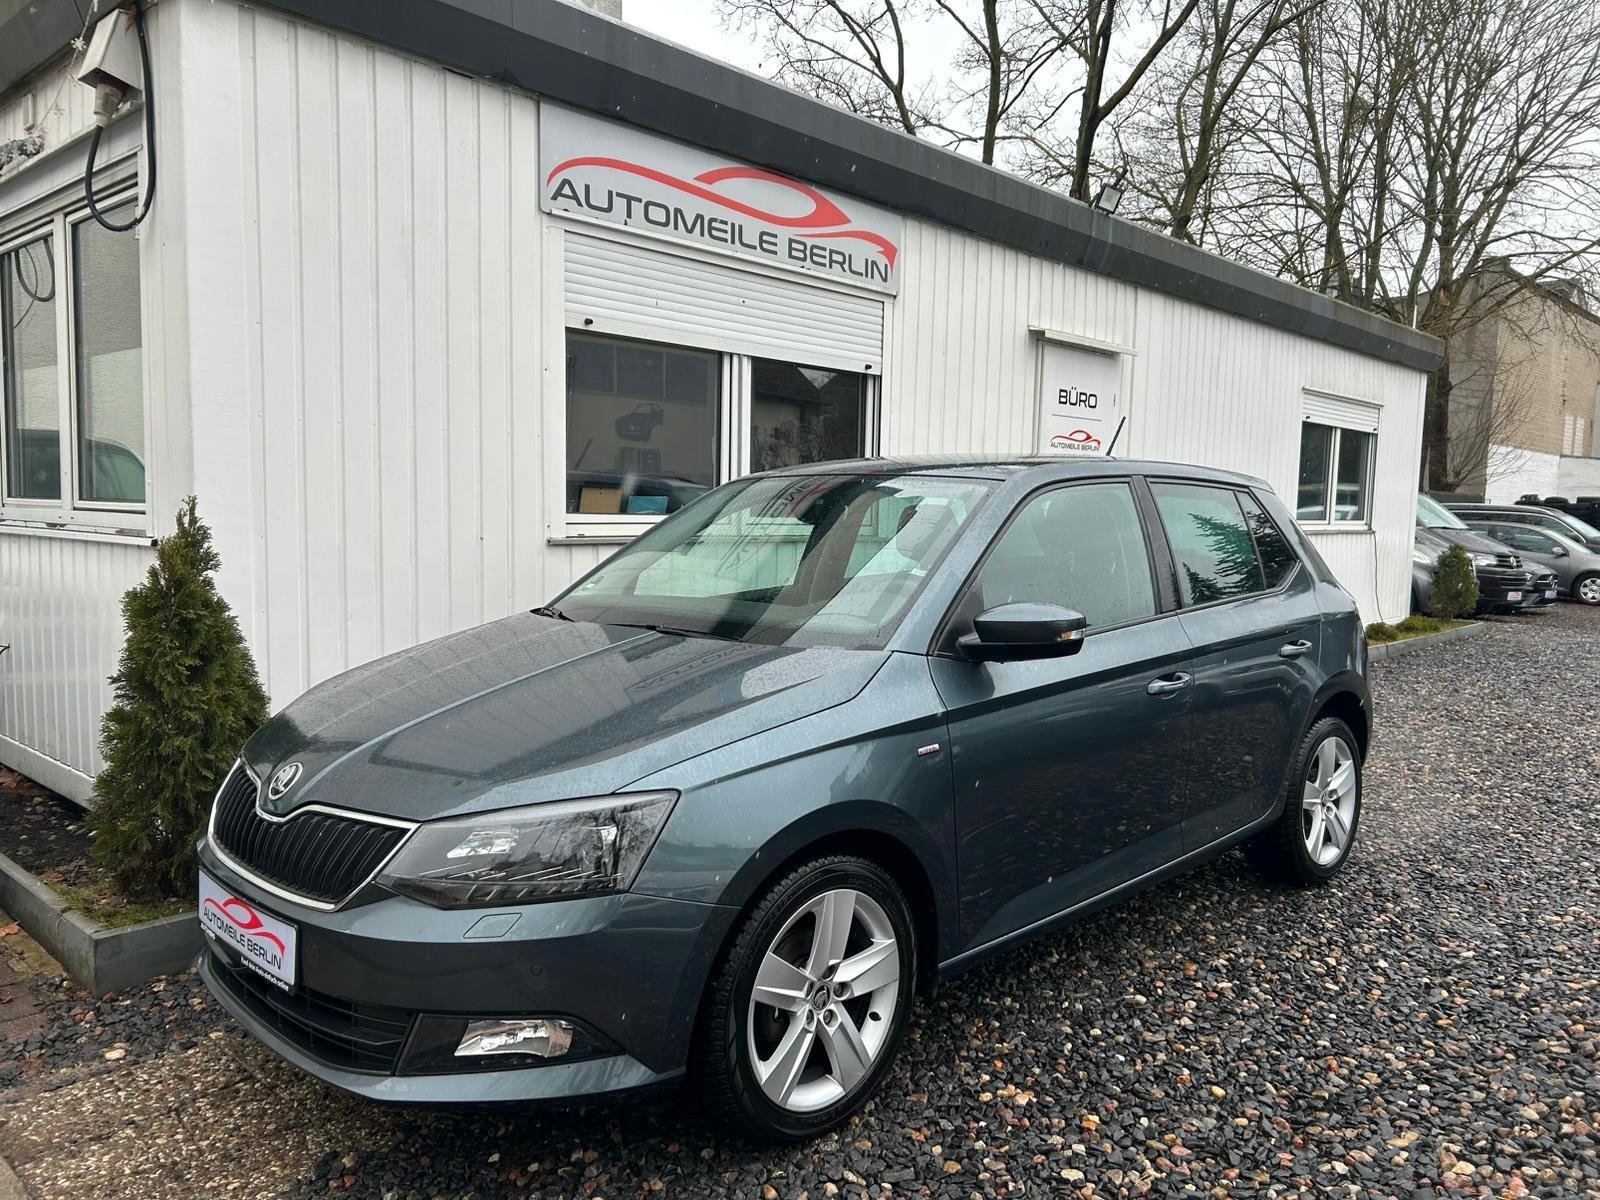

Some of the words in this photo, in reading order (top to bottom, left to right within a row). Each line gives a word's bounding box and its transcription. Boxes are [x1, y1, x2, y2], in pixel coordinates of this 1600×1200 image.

[550, 178, 778, 255] AUTOMEILE
[787, 237, 888, 283] BERLIN
[1058, 386, 1098, 409] BÜRO
[1050, 442, 1080, 451] AUTOMEILE
[1081, 444, 1099, 452] BERLIN
[203, 906, 246, 948] AUTOMEILE
[246, 937, 282, 970] BERLIN
